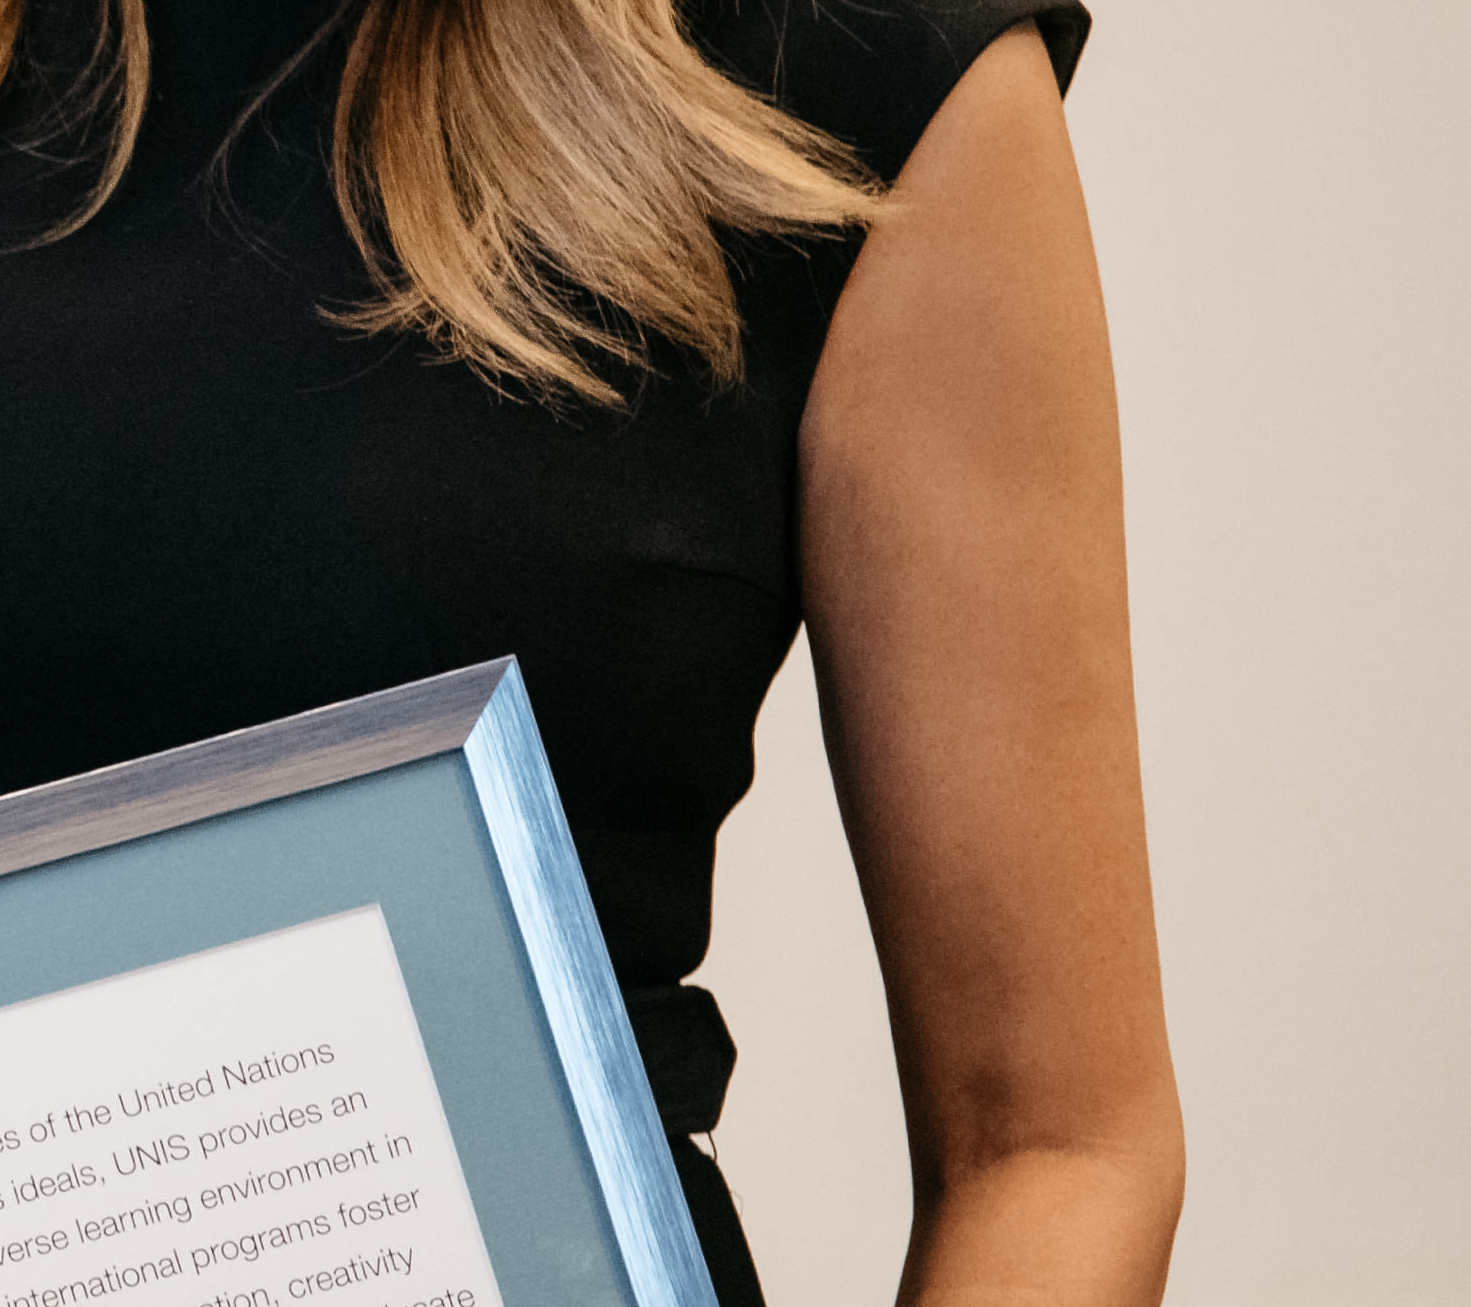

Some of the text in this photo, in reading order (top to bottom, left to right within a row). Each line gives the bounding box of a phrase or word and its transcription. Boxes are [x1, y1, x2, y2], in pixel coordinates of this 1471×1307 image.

[29, 1112, 56, 1143] of
[64, 1105, 112, 1133] the
[118, 1069, 215, 1117] United
[221, 1044, 335, 1090] Nations
[13, 1163, 105, 1205] ideals,
[112, 1134, 190, 1176] UNIS
[198, 1104, 323, 1160] provides
[331, 1091, 368, 1117] an
[75, 1196, 193, 1243] learning
[200, 1141, 379, 1209] environment
[386, 1136, 412, 1159] in
[190, 1215, 331, 1276] programs
[338, 1189, 419, 1229] foster
[288, 1248, 413, 1299] creativity
